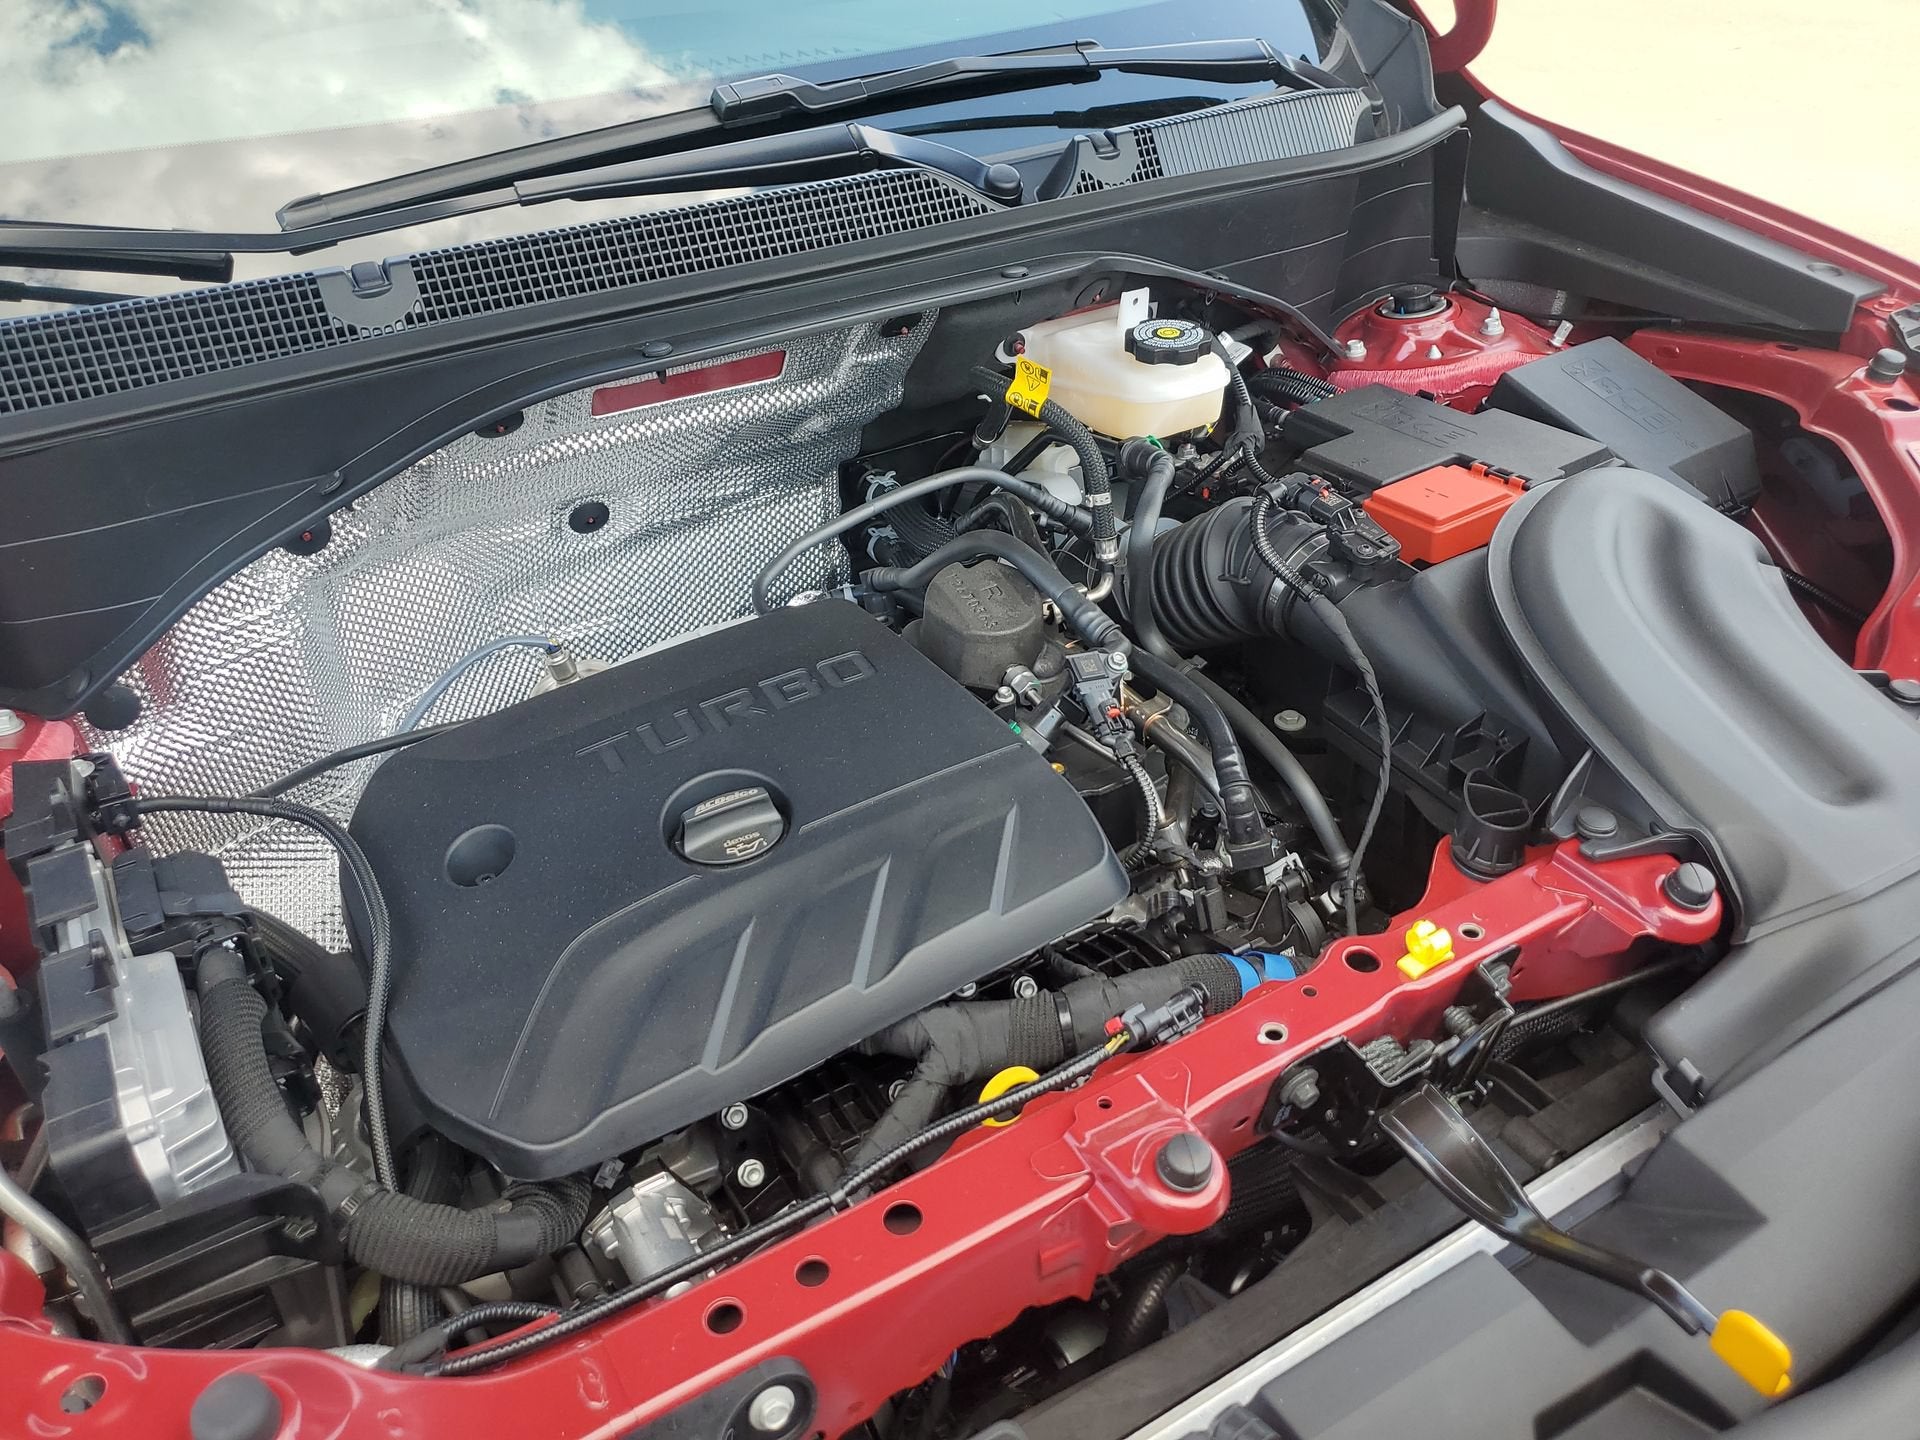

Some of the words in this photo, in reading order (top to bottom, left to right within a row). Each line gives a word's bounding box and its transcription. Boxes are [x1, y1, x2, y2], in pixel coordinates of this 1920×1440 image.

[575, 650, 877, 774] TURBO
[694, 788, 759, 816] ACDelco
[723, 831, 761, 848] dexos
